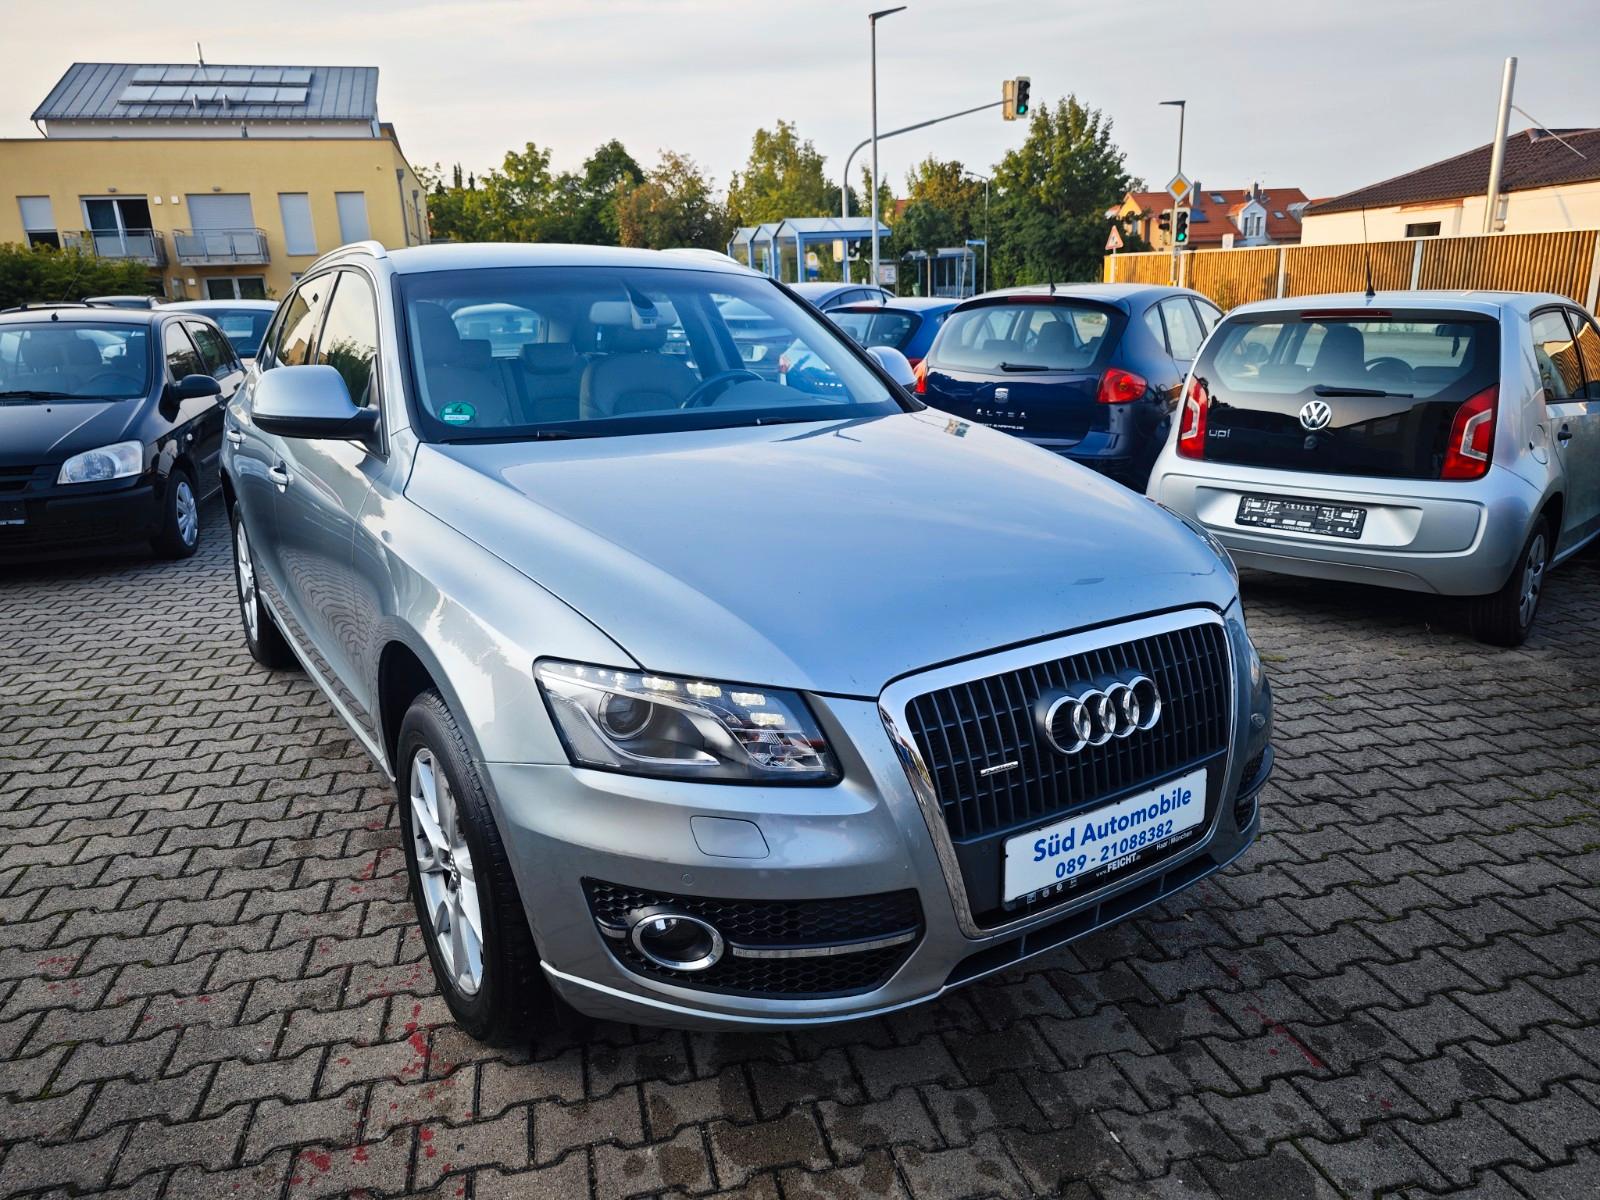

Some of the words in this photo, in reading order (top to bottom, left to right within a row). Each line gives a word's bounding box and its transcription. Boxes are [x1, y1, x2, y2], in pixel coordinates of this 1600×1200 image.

[454, 403, 463, 414] 4
[1208, 428, 1231, 439] up!
[1033, 828, 1075, 862] Süd
[1080, 787, 1192, 847] Automobile
[1055, 854, 1087, 879] 089
[1100, 819, 1173, 863] 21088382
